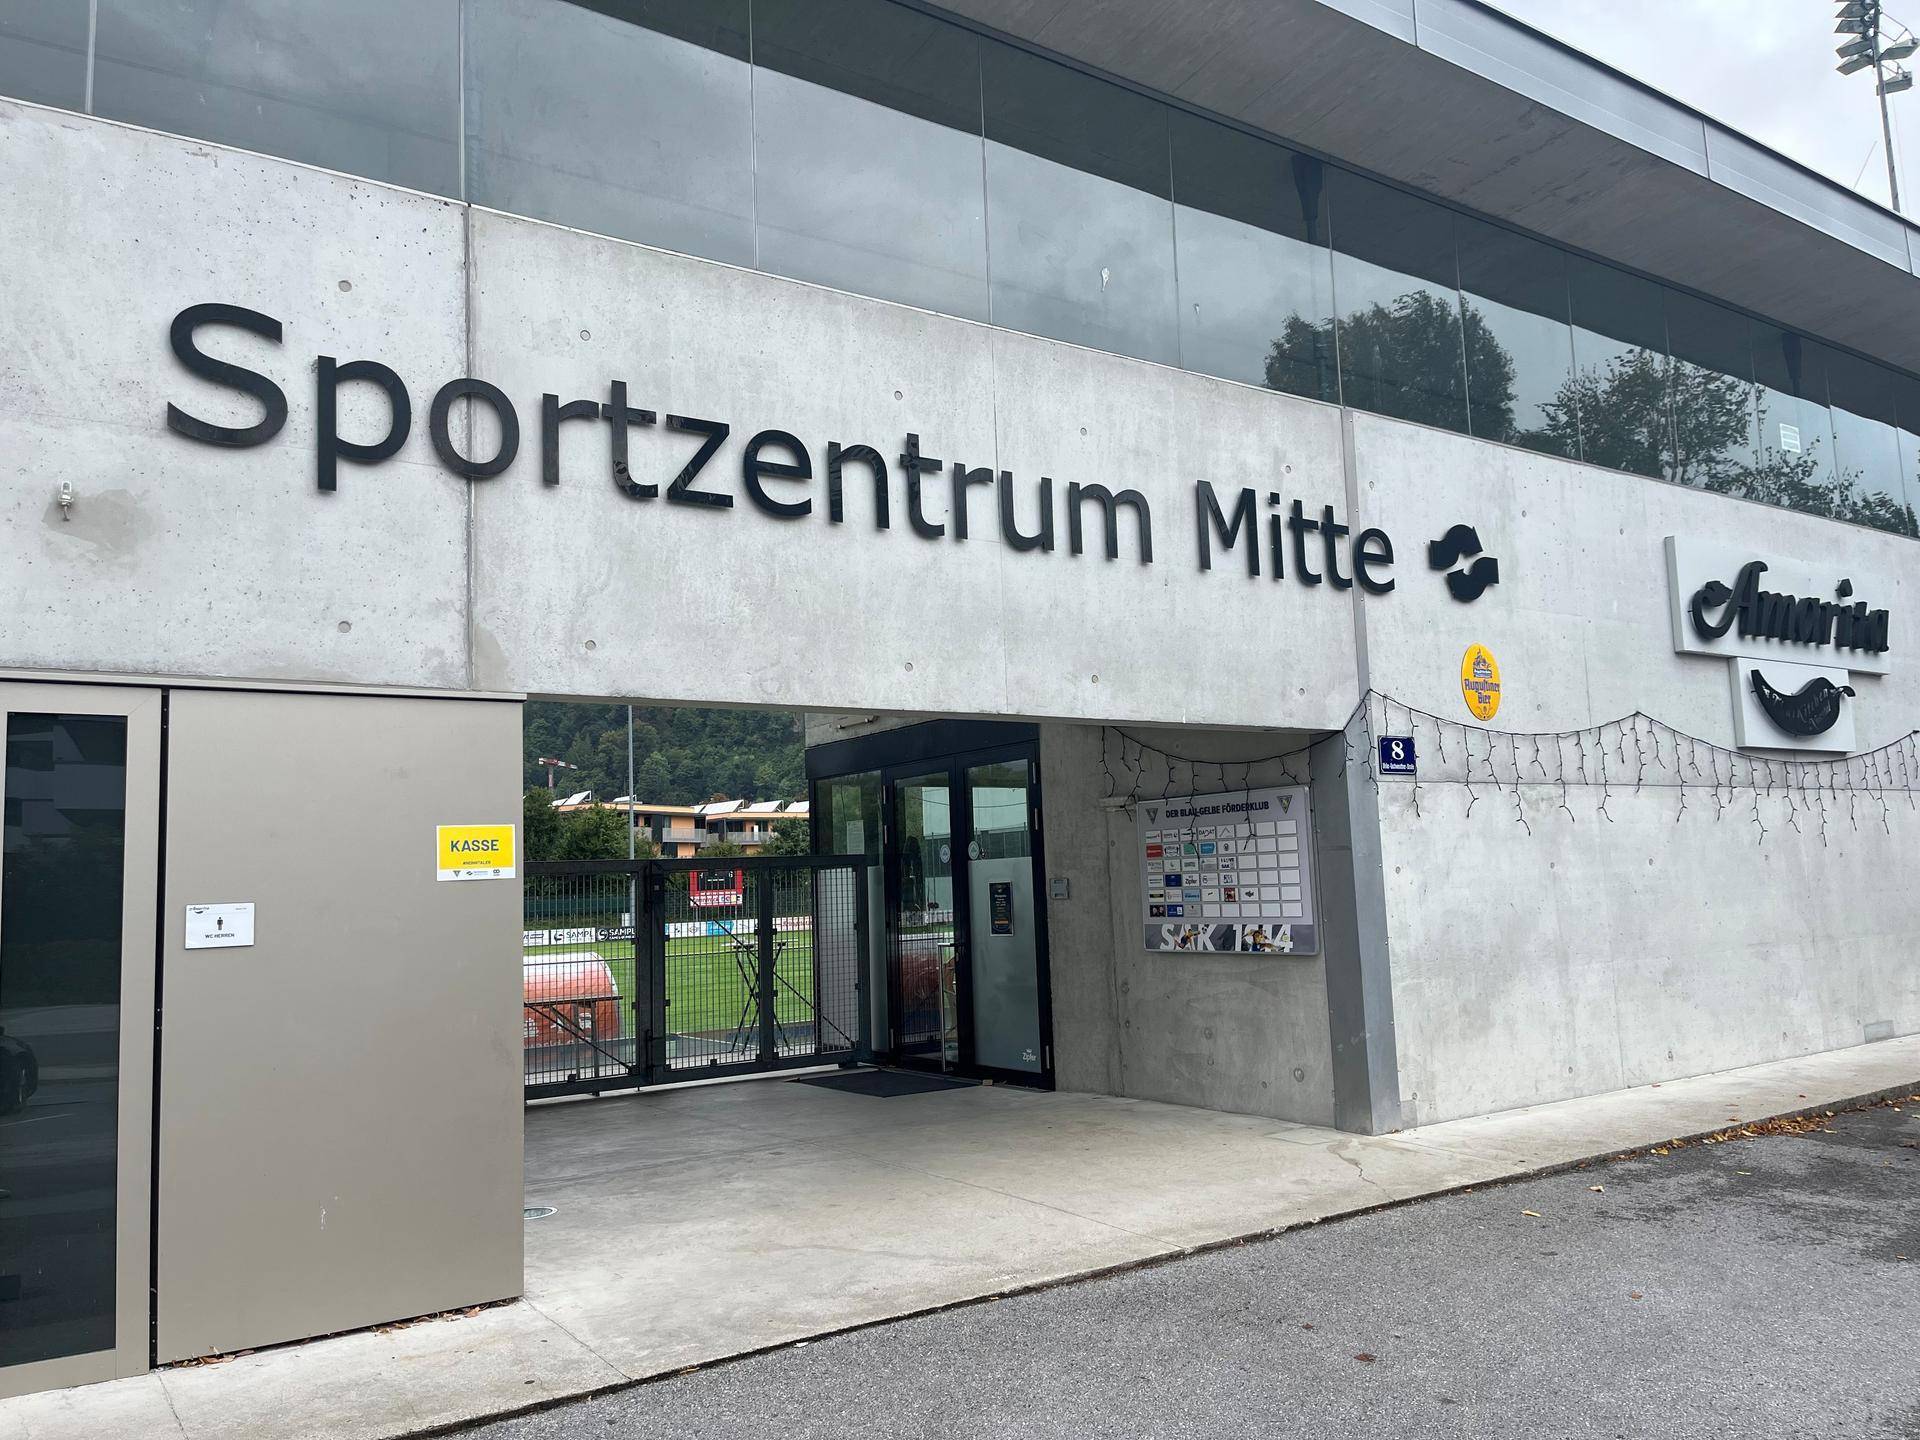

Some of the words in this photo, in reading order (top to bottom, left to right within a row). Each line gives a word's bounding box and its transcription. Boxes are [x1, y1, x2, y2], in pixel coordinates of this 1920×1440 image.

[167, 302, 1154, 565] Sportzentrum
[1196, 479, 1396, 595] Mitte
[1691, 560, 1890, 653] Amarita
[1478, 691, 1491, 705] Bier
[1391, 740, 1405, 760] 8
[1165, 810, 1179, 818] DER
[1179, 805, 1221, 817] BLAU-GELBE
[1222, 801, 1269, 813] FÖRDERKLUB
[450, 839, 500, 853] KASSE
[1160, 924, 1217, 951] SAK
